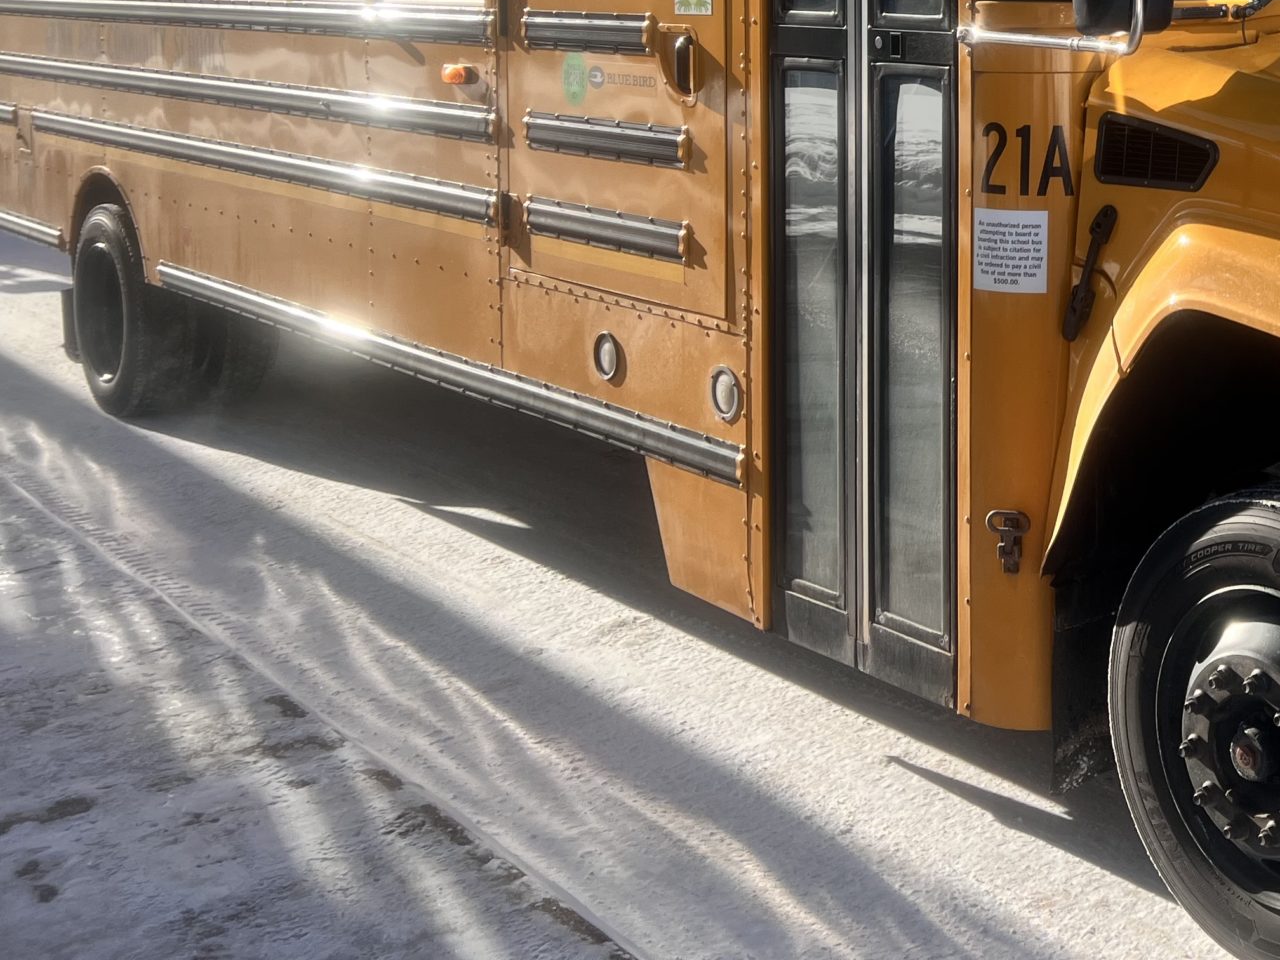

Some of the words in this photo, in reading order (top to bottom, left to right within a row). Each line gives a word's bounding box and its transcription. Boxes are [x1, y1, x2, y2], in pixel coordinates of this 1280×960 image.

[607, 73, 631, 86] BLUE
[632, 75, 657, 87] BIRD
[981, 122, 1075, 197] 21A
[1191, 544, 1232, 562] COOPER
[1238, 543, 1263, 552] TIRE
